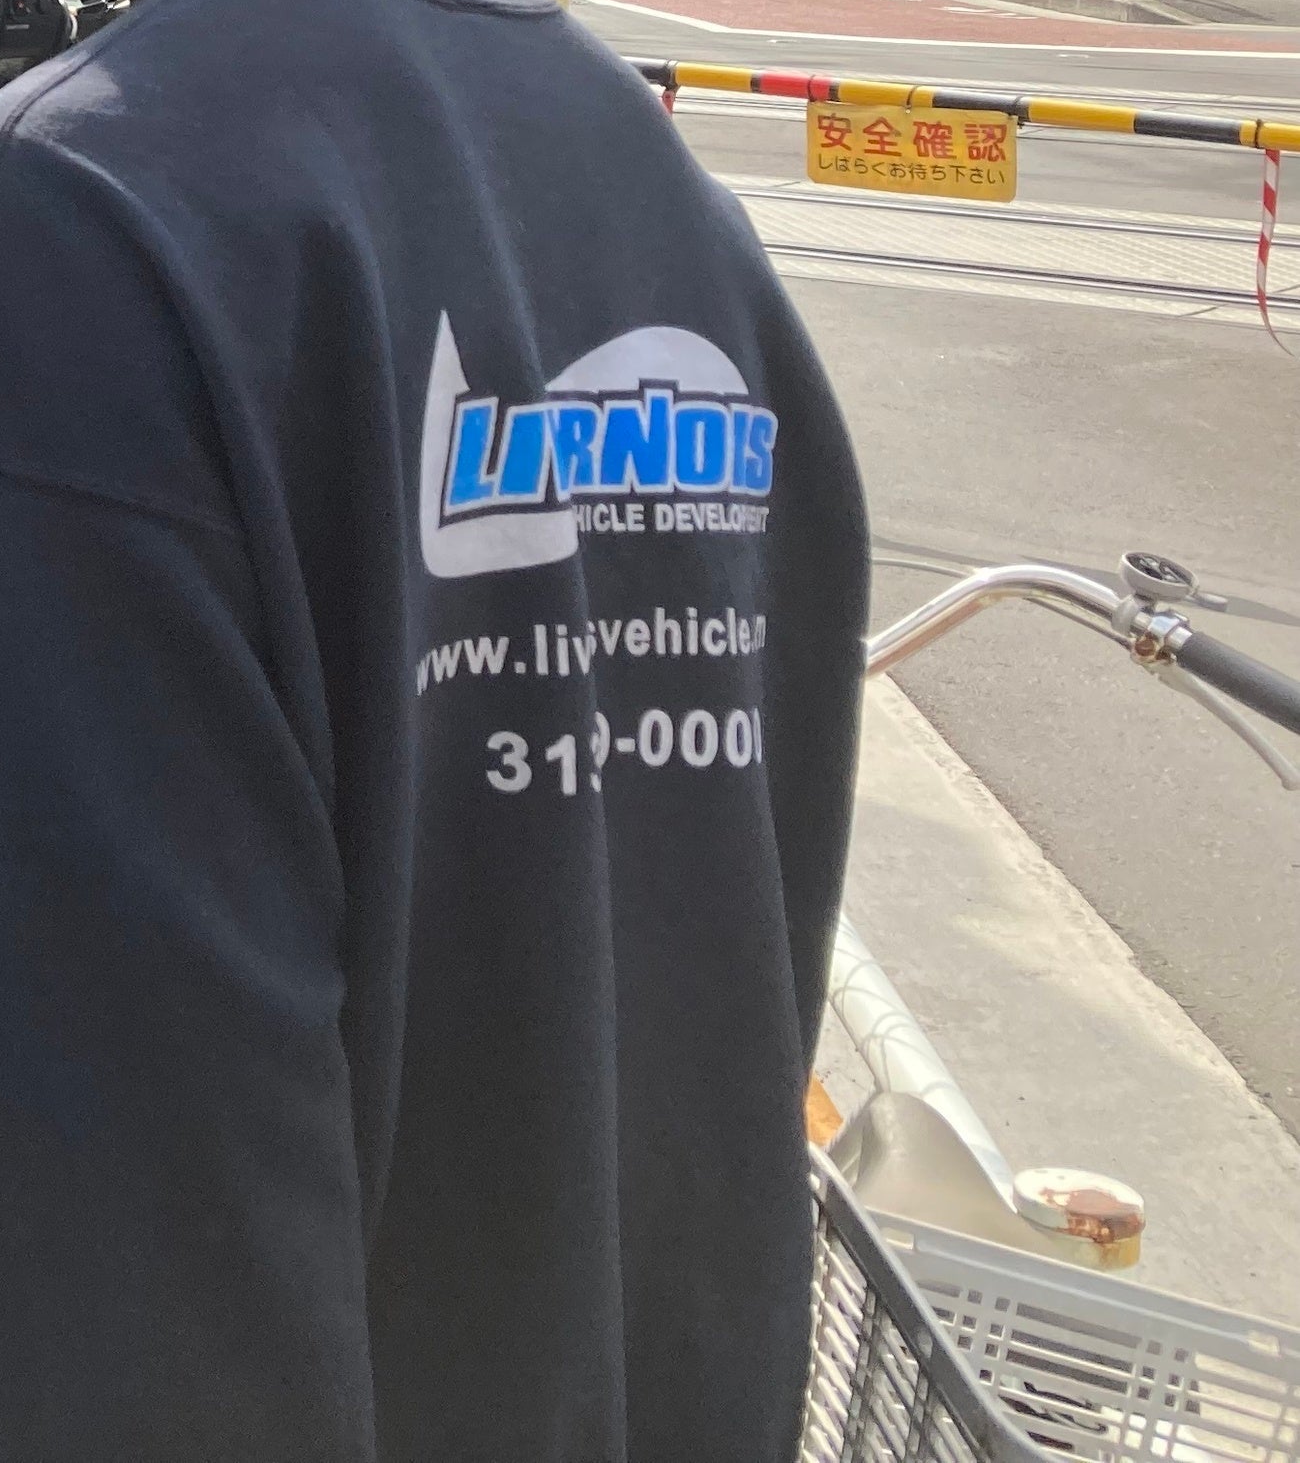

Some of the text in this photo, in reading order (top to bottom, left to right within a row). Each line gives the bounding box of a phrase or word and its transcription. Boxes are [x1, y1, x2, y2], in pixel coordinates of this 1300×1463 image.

[817, 112, 1008, 163] 安全確認
[818, 153, 1005, 185] しばらくお待ち下さい
